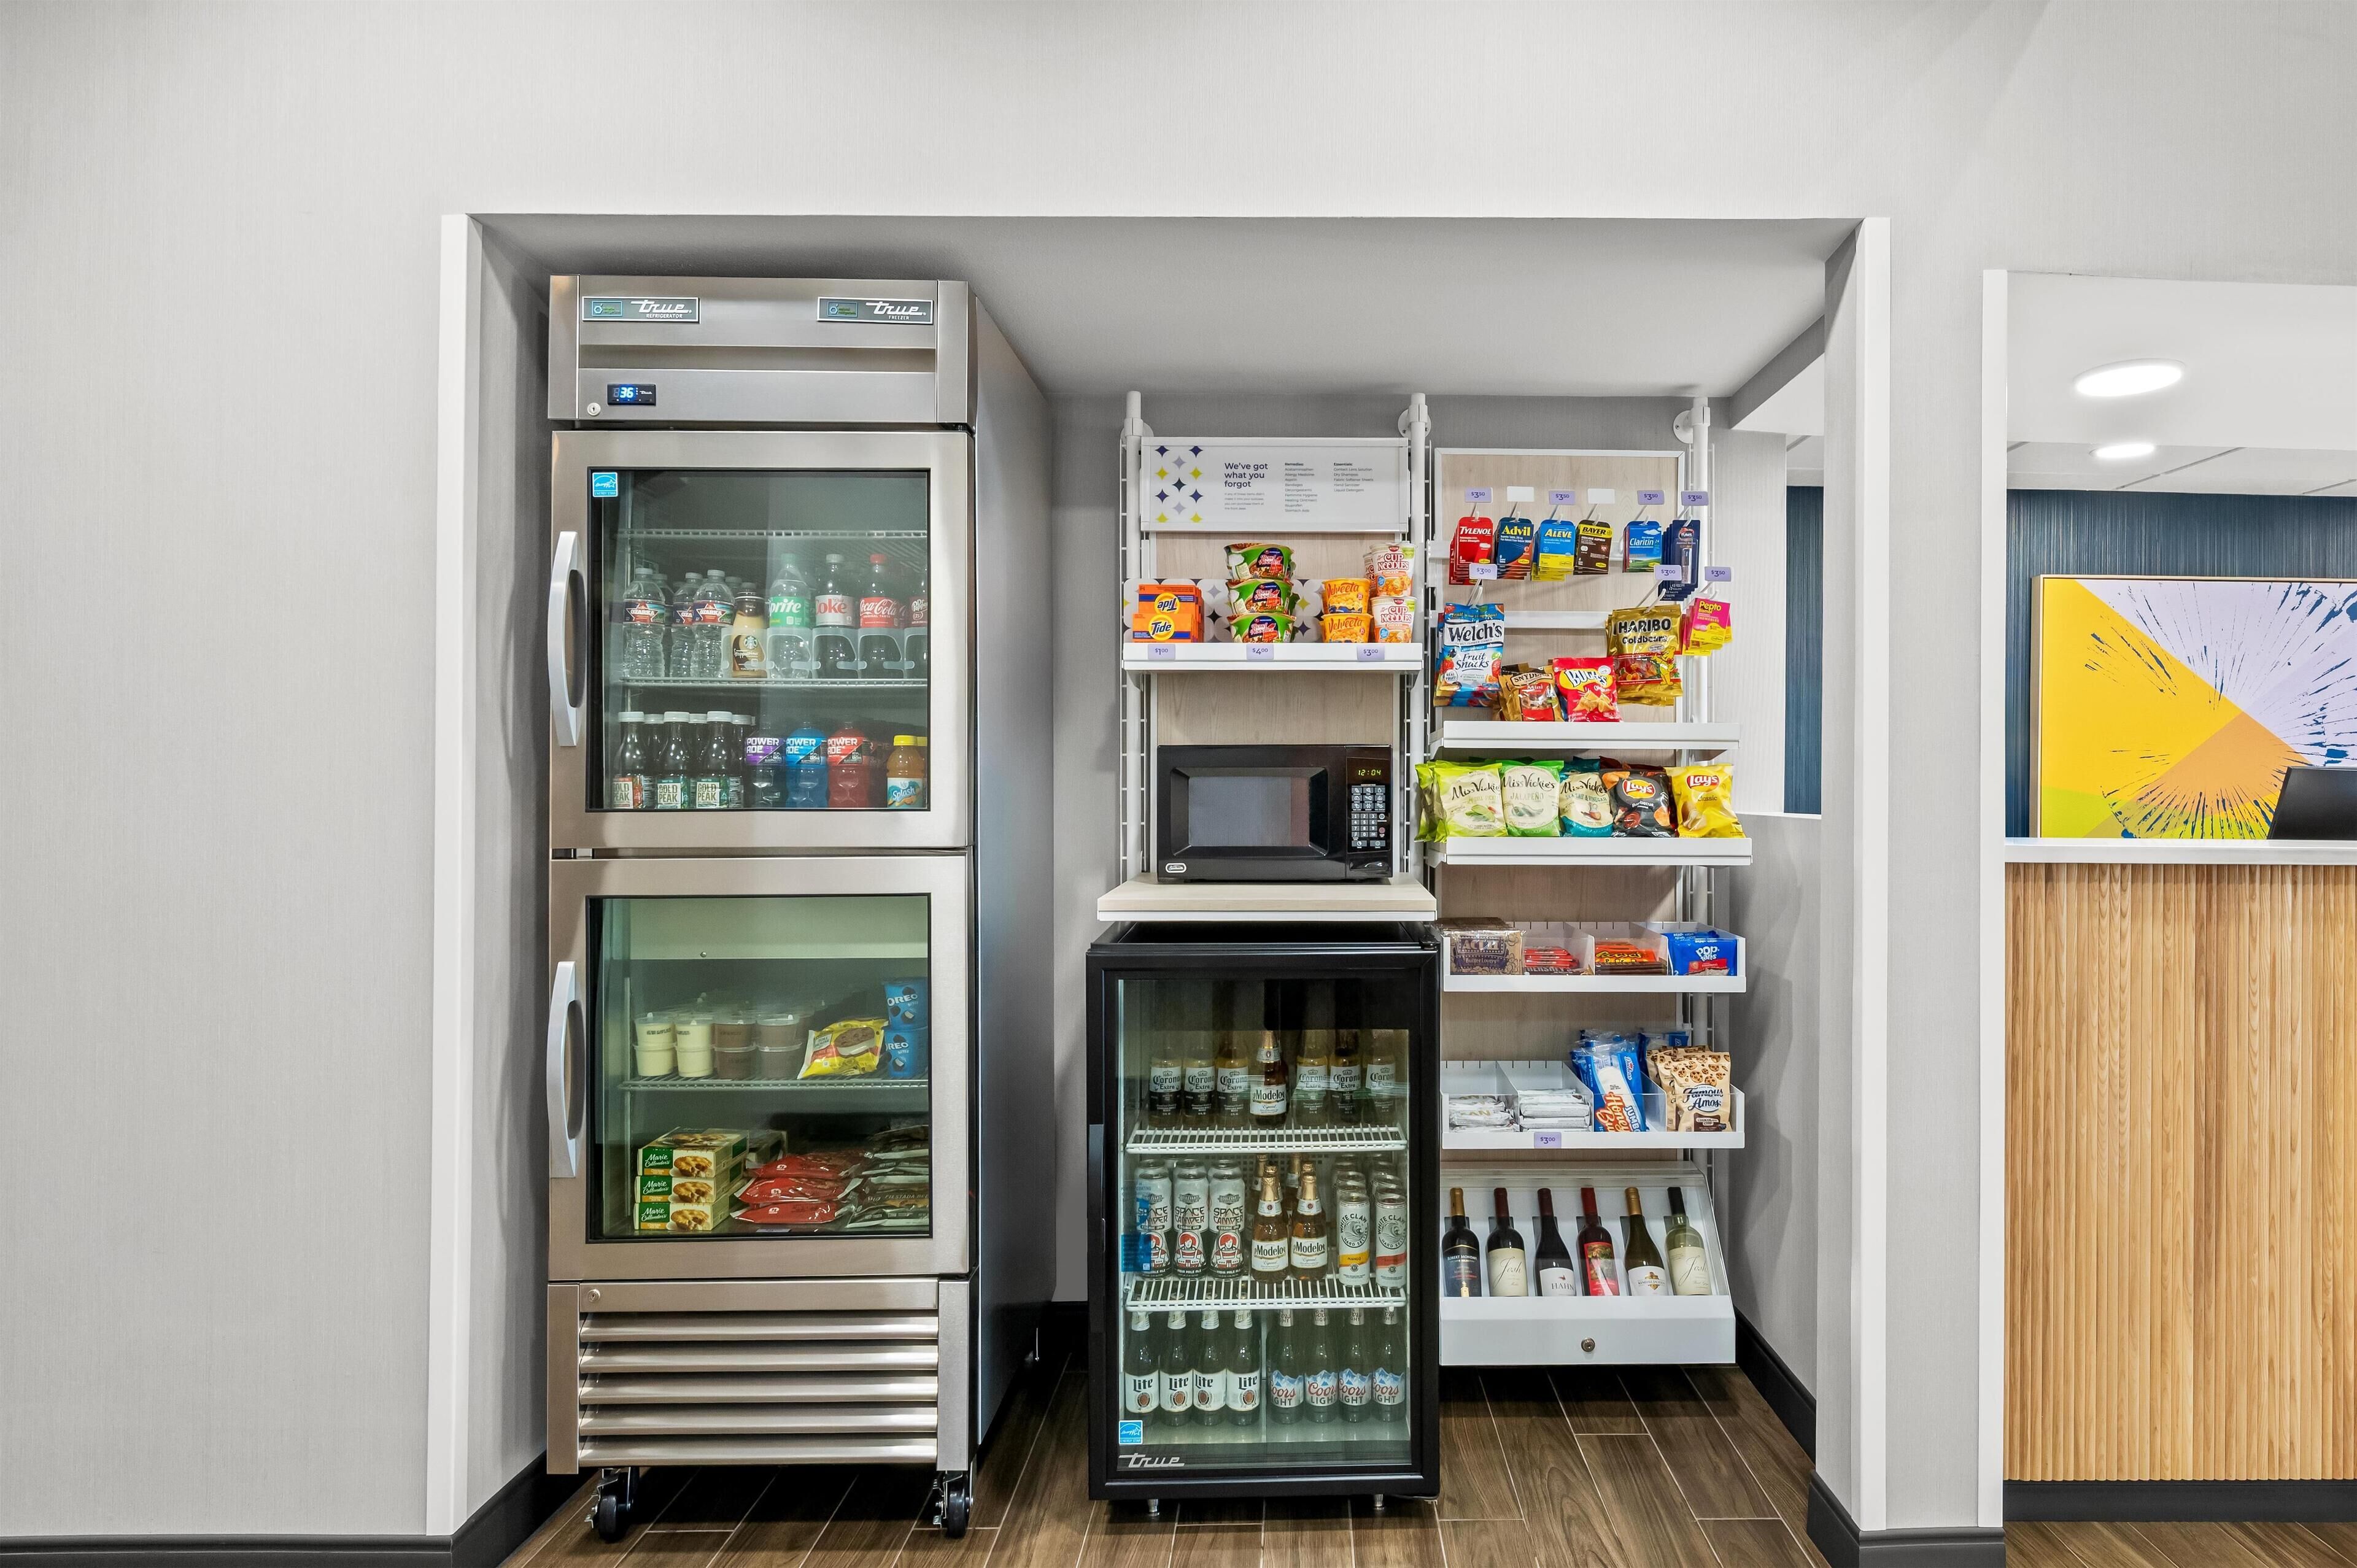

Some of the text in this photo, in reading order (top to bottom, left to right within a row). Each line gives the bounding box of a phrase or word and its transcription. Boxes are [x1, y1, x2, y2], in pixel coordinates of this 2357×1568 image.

[620, 387, 633, 398] 36
[1224, 480, 1252, 489] forgot
[1459, 526, 1492, 535] TYLENOL
[1501, 525, 1531, 536] Advil
[1544, 529, 1572, 538] ALEVE
[1384, 553, 1404, 563] CUP
[1377, 562, 1409, 571] NOODLES
[1326, 582, 1360, 596] Velveeta
[769, 598, 802, 614] prite
[1156, 597, 1177, 611] Tide
[1698, 601, 1722, 611] Pepto
[1388, 606, 1408, 615] CUP
[1380, 614, 1412, 623] NOODLES
[1151, 621, 1172, 636] Tide
[1328, 616, 1363, 633] Velveeta
[1618, 618, 1672, 635] HARIBO
[1448, 622, 1503, 643] Welch's
[1622, 635, 1668, 644] Goldbears
[1463, 652, 1486, 662] Fruit
[1455, 660, 1490, 670] Snacks
[746, 738, 780, 746] POWER
[786, 738, 816, 746] POWER
[827, 738, 857, 746] POWER
[746, 745, 763, 754] ADE
[827, 746, 842, 754] ADE
[1522, 772, 1555, 792] Vickie's
[1689, 774, 1719, 787] Lay's
[659, 784, 678, 794] GOLD
[698, 783, 716, 792] GOLD
[1560, 782, 1585, 795] Miss
[1624, 780, 1654, 794] Lay's
[659, 793, 678, 803] PEAK
[698, 792, 716, 801] PEAK
[892, 787, 916, 801] Splash
[1452, 785, 1474, 801] Miss
[1510, 792, 1544, 801] JALAPEÑO
[887, 993, 918, 1006] OREO
[1153, 1075, 1180, 1085] Corona
[1188, 1075, 1215, 1085] Corona
[1333, 1073, 1360, 1083] Corona
[1255, 1089, 1285, 1100] Modelo
[1682, 1087, 1724, 1103] Famous
[1687, 1097, 1722, 1111] Amos
[1603, 1092, 1631, 1132] Honey
[644, 1154, 668, 1163] Marie
[643, 1181, 667, 1190] Marie
[643, 1186, 669, 1195] Callender's
[641, 1207, 665, 1217] Marie
[1175, 1206, 1205, 1216] SPACE
[1213, 1205, 1244, 1216] SPACE
[641, 1213, 667, 1222] Callender's
[1175, 1215, 1205, 1224] CAMPER
[1213, 1215, 1244, 1224] CAMPER
[1340, 1213, 1368, 1234] WHITE CLAW
[1377, 1215, 1406, 1235] WHITE CLAW
[1344, 1237, 1356, 1247] HARD
[1256, 1244, 1284, 1256] Modelo
[1295, 1242, 1324, 1254] Modelo
[1495, 1256, 1522, 1288] Josh
[1678, 1255, 1709, 1287] Josh
[1551, 1283, 1574, 1291] HAHN
[1132, 1378, 1153, 1392] Lite
[1169, 1377, 1189, 1391] Lite
[1195, 1374, 1213, 1389] Lite
[1238, 1375, 1258, 1390] Lite
[1307, 1381, 1337, 1397] Coor
[1118, 1453, 1185, 1468] true
